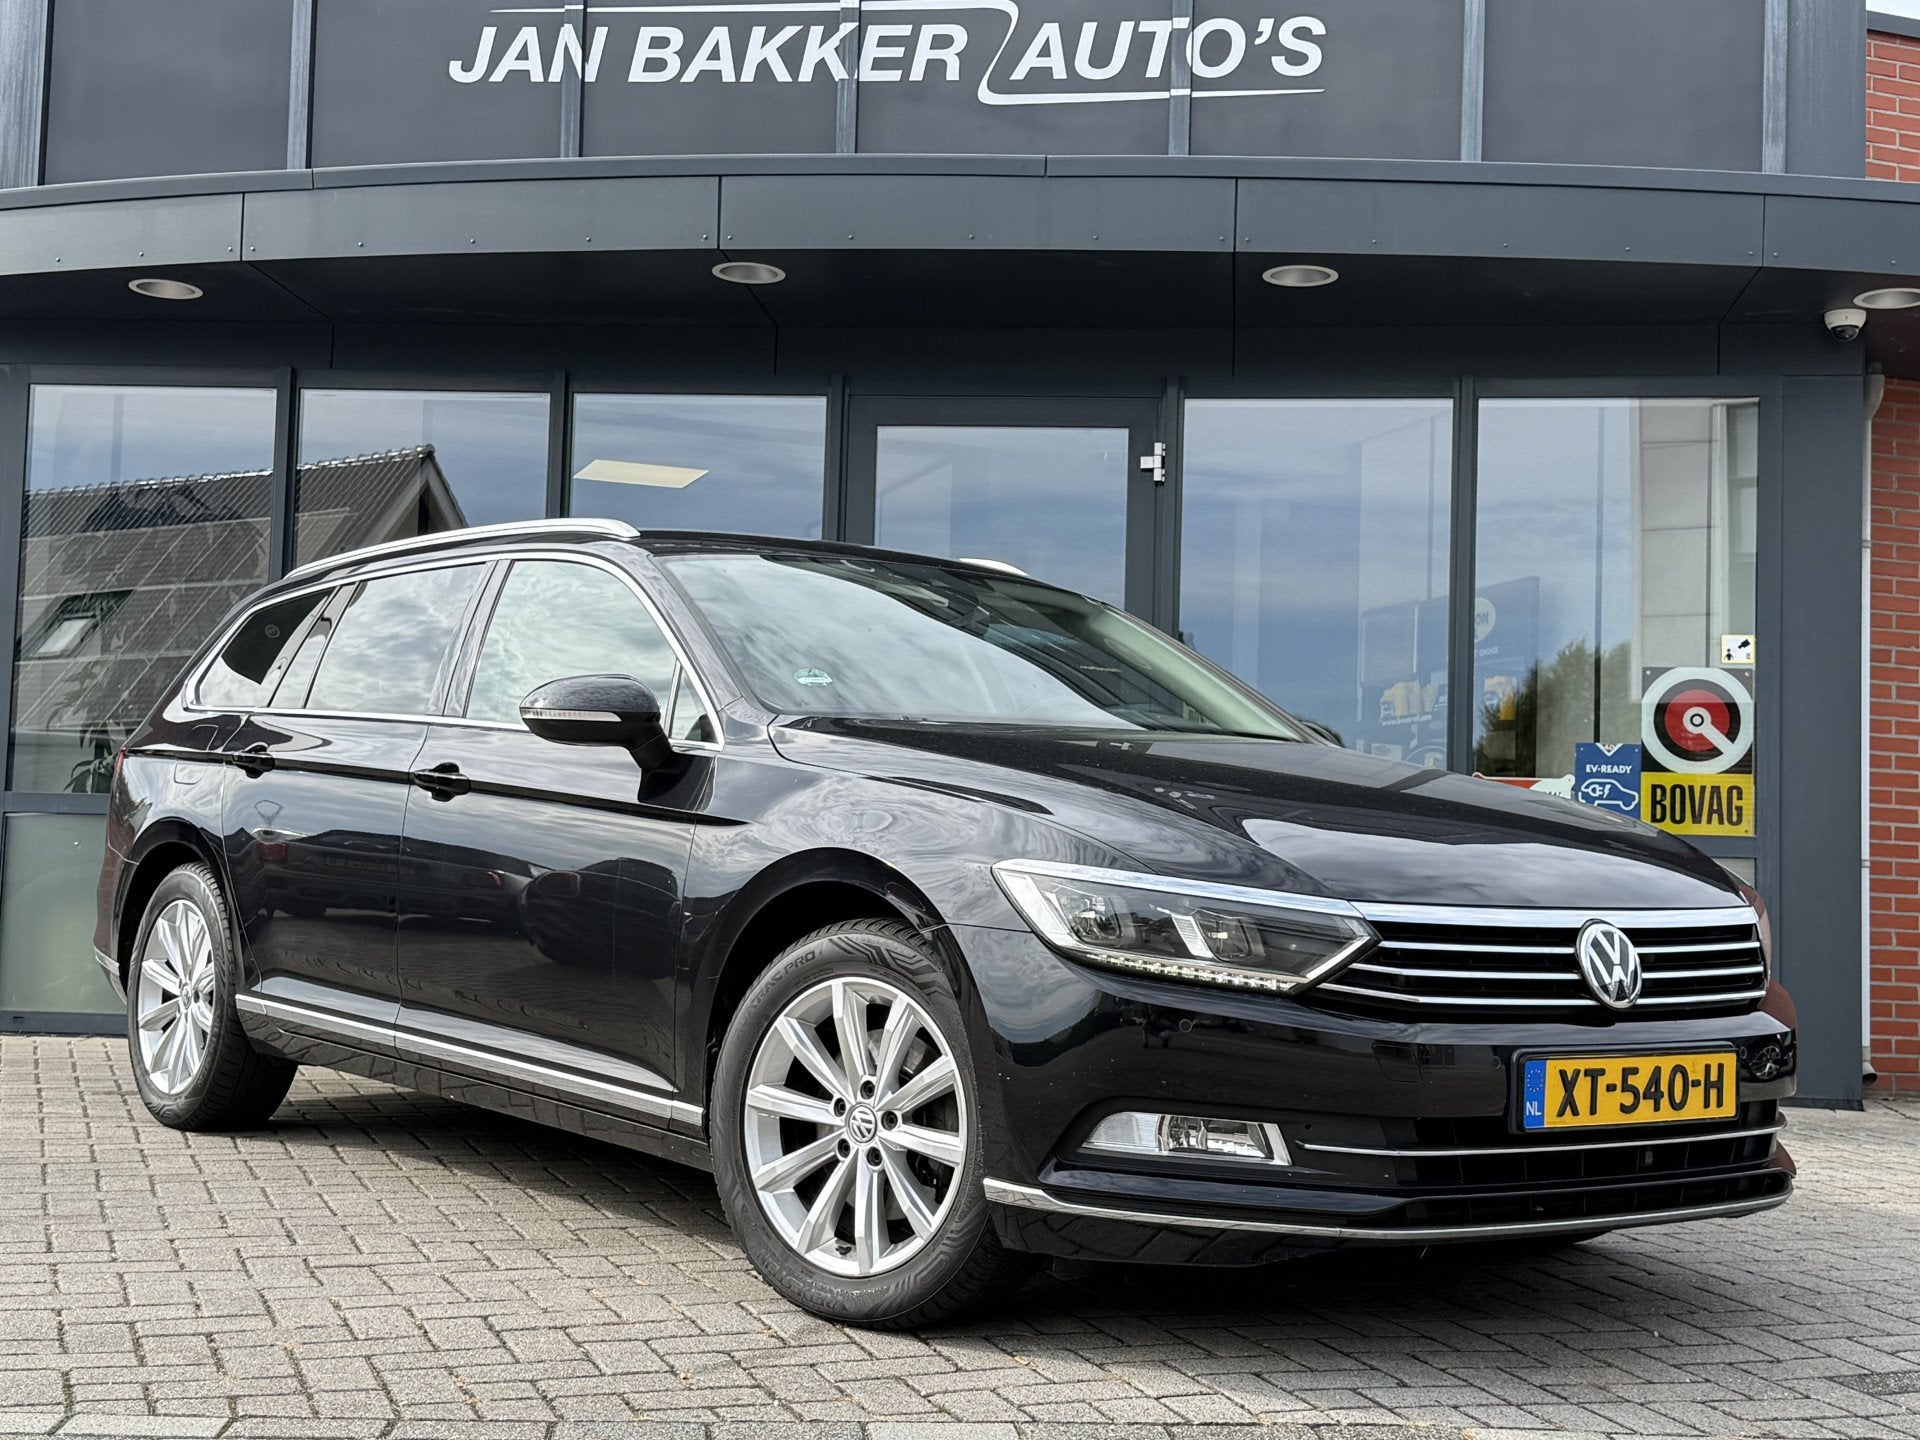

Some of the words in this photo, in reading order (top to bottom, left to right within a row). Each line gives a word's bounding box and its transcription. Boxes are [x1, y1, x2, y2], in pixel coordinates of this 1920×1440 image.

[449, 24, 609, 83] JAN
[627, 22, 968, 83] BAKKER
[1009, 16, 1327, 80] AUTO'S
[1651, 783, 1743, 826] BOVAG
[1525, 1101, 1542, 1116] NL
[1556, 1062, 1724, 1117] XT-540-H
